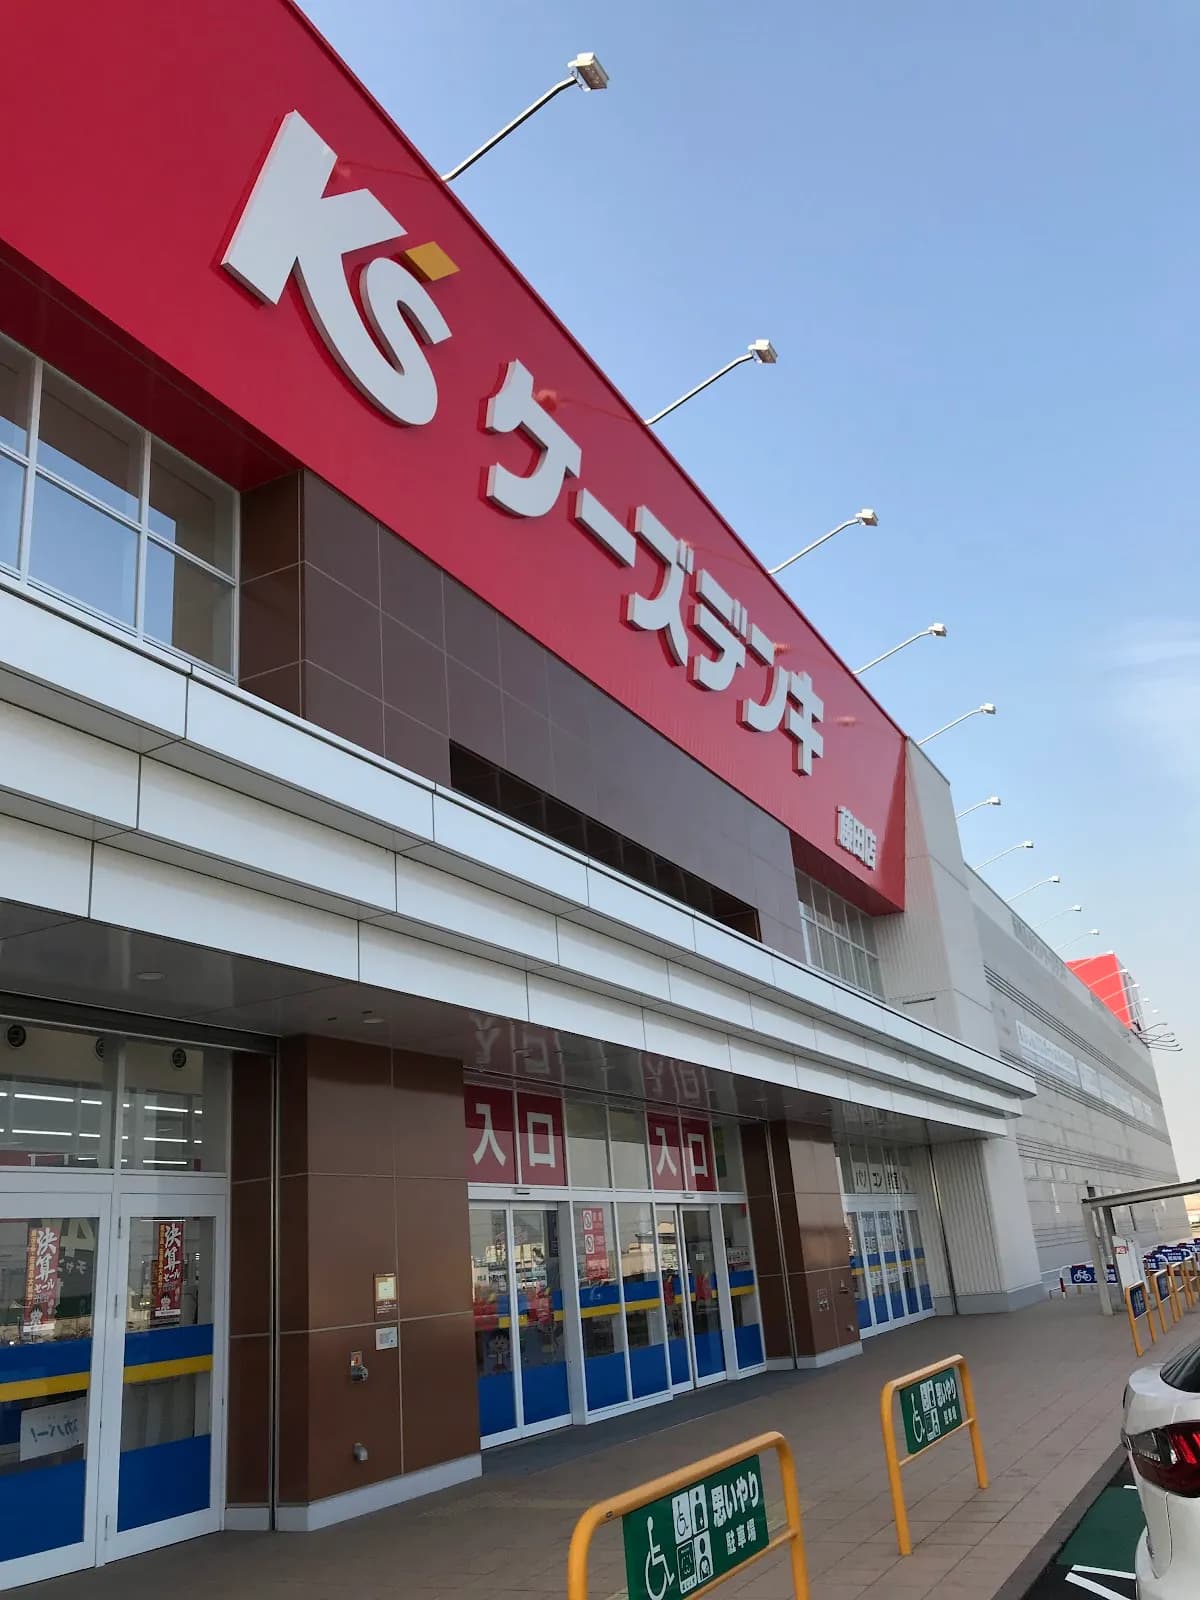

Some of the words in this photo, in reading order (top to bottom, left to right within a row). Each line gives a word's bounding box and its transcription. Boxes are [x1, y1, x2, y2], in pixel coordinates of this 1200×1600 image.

[482, 358, 825, 776] ケーズデンキ
[473, 1103, 556, 1168] 入口
[655, 1125, 709, 1178] 入口
[36, 1227, 58, 1281] 決算
[164, 1223, 182, 1272] 決算
[164, 1269, 181, 1282] セール
[935, 1377, 957, 1407] 思いやり
[711, 1471, 760, 1528] 思いやり
[725, 1518, 757, 1556] 駐車場
